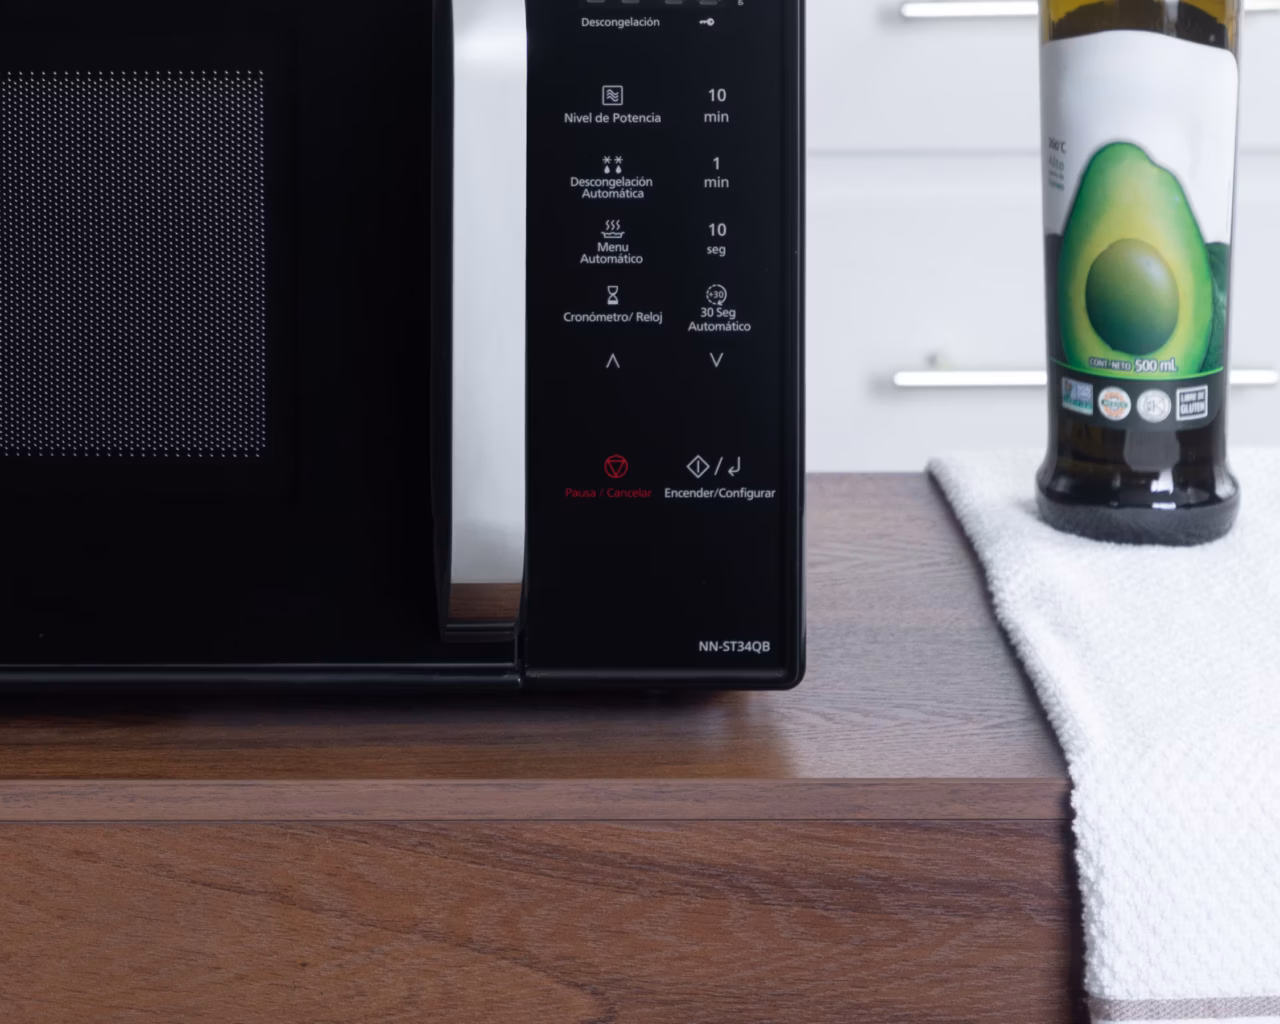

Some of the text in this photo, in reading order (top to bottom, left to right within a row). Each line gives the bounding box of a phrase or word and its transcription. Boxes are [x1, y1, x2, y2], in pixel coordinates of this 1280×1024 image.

[582, 17, 660, 29] Descongelación
[708, 89, 727, 103] 10
[564, 113, 662, 124] Nivel de Potencia
[703, 111, 730, 123] min
[713, 156, 720, 170] 1
[571, 176, 652, 190] Descongelación
[703, 176, 730, 188] min
[581, 187, 645, 199] Automática
[708, 223, 727, 237] 10
[597, 242, 629, 252] Menu
[706, 246, 727, 258] seg
[579, 253, 644, 265] Automático
[563, 312, 663, 325] Cronómetro/ Reloj
[700, 307, 737, 321] 30 Seg
[687, 319, 752, 332] Automático
[1135, 359, 1158, 372] 500
[565, 488, 597, 499] Pausa
[605, 488, 653, 499] Cancelar
[664, 487, 777, 501] Encender/Configurar
[698, 641, 771, 655] NN-ST34QB
